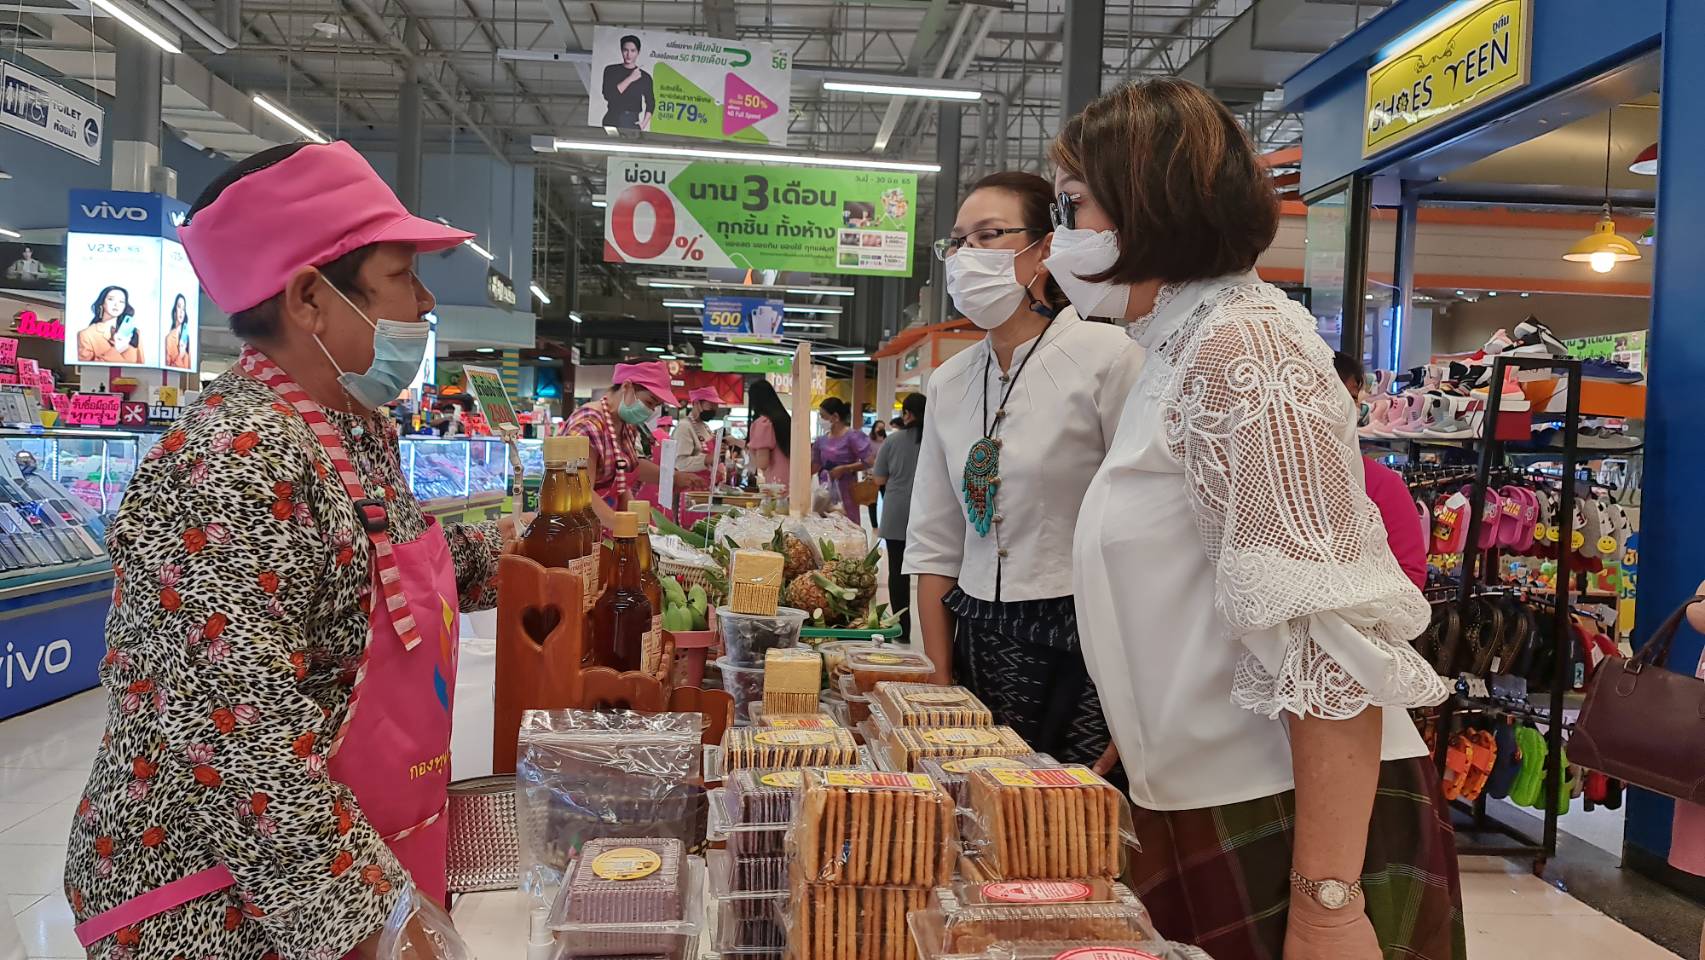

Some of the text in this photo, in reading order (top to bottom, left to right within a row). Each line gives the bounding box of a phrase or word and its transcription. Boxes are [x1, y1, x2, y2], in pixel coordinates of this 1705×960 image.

[772, 57, 787, 70] 5G
[52, 101, 81, 120] TOILET
[744, 94, 768, 109] 50%
[658, 100, 708, 124] ลด 79%
[54, 119, 76, 139] ห้องน้ำ
[625, 163, 666, 184] ผ่อน
[690, 175, 837, 211] นาน 3 เดือน
[80, 201, 148, 221] vivo
[717, 214, 836, 240] ทุกชิ้น ทั้งห้าง
[710, 311, 741, 326] 500
[0, 639, 72, 689] ivo
